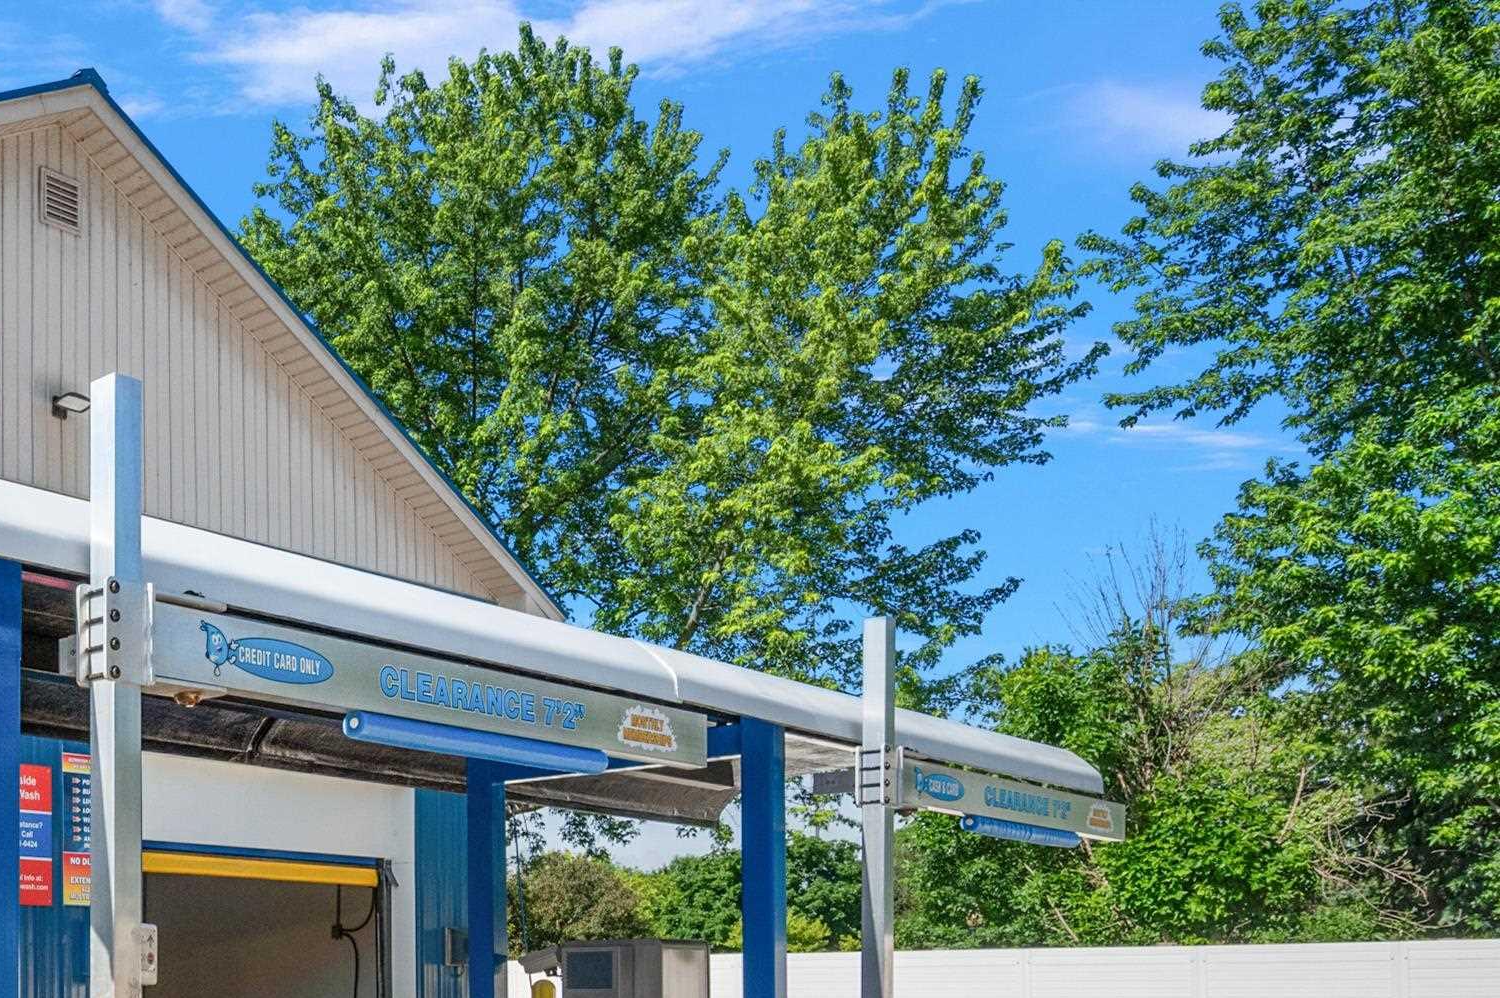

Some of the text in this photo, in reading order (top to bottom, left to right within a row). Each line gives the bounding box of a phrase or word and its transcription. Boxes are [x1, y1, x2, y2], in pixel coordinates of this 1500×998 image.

[238, 646, 321, 676] CREDIT CARD ONLY
[379, 664, 535, 723] CLEARANCE
[70, 857, 80, 865] NO
